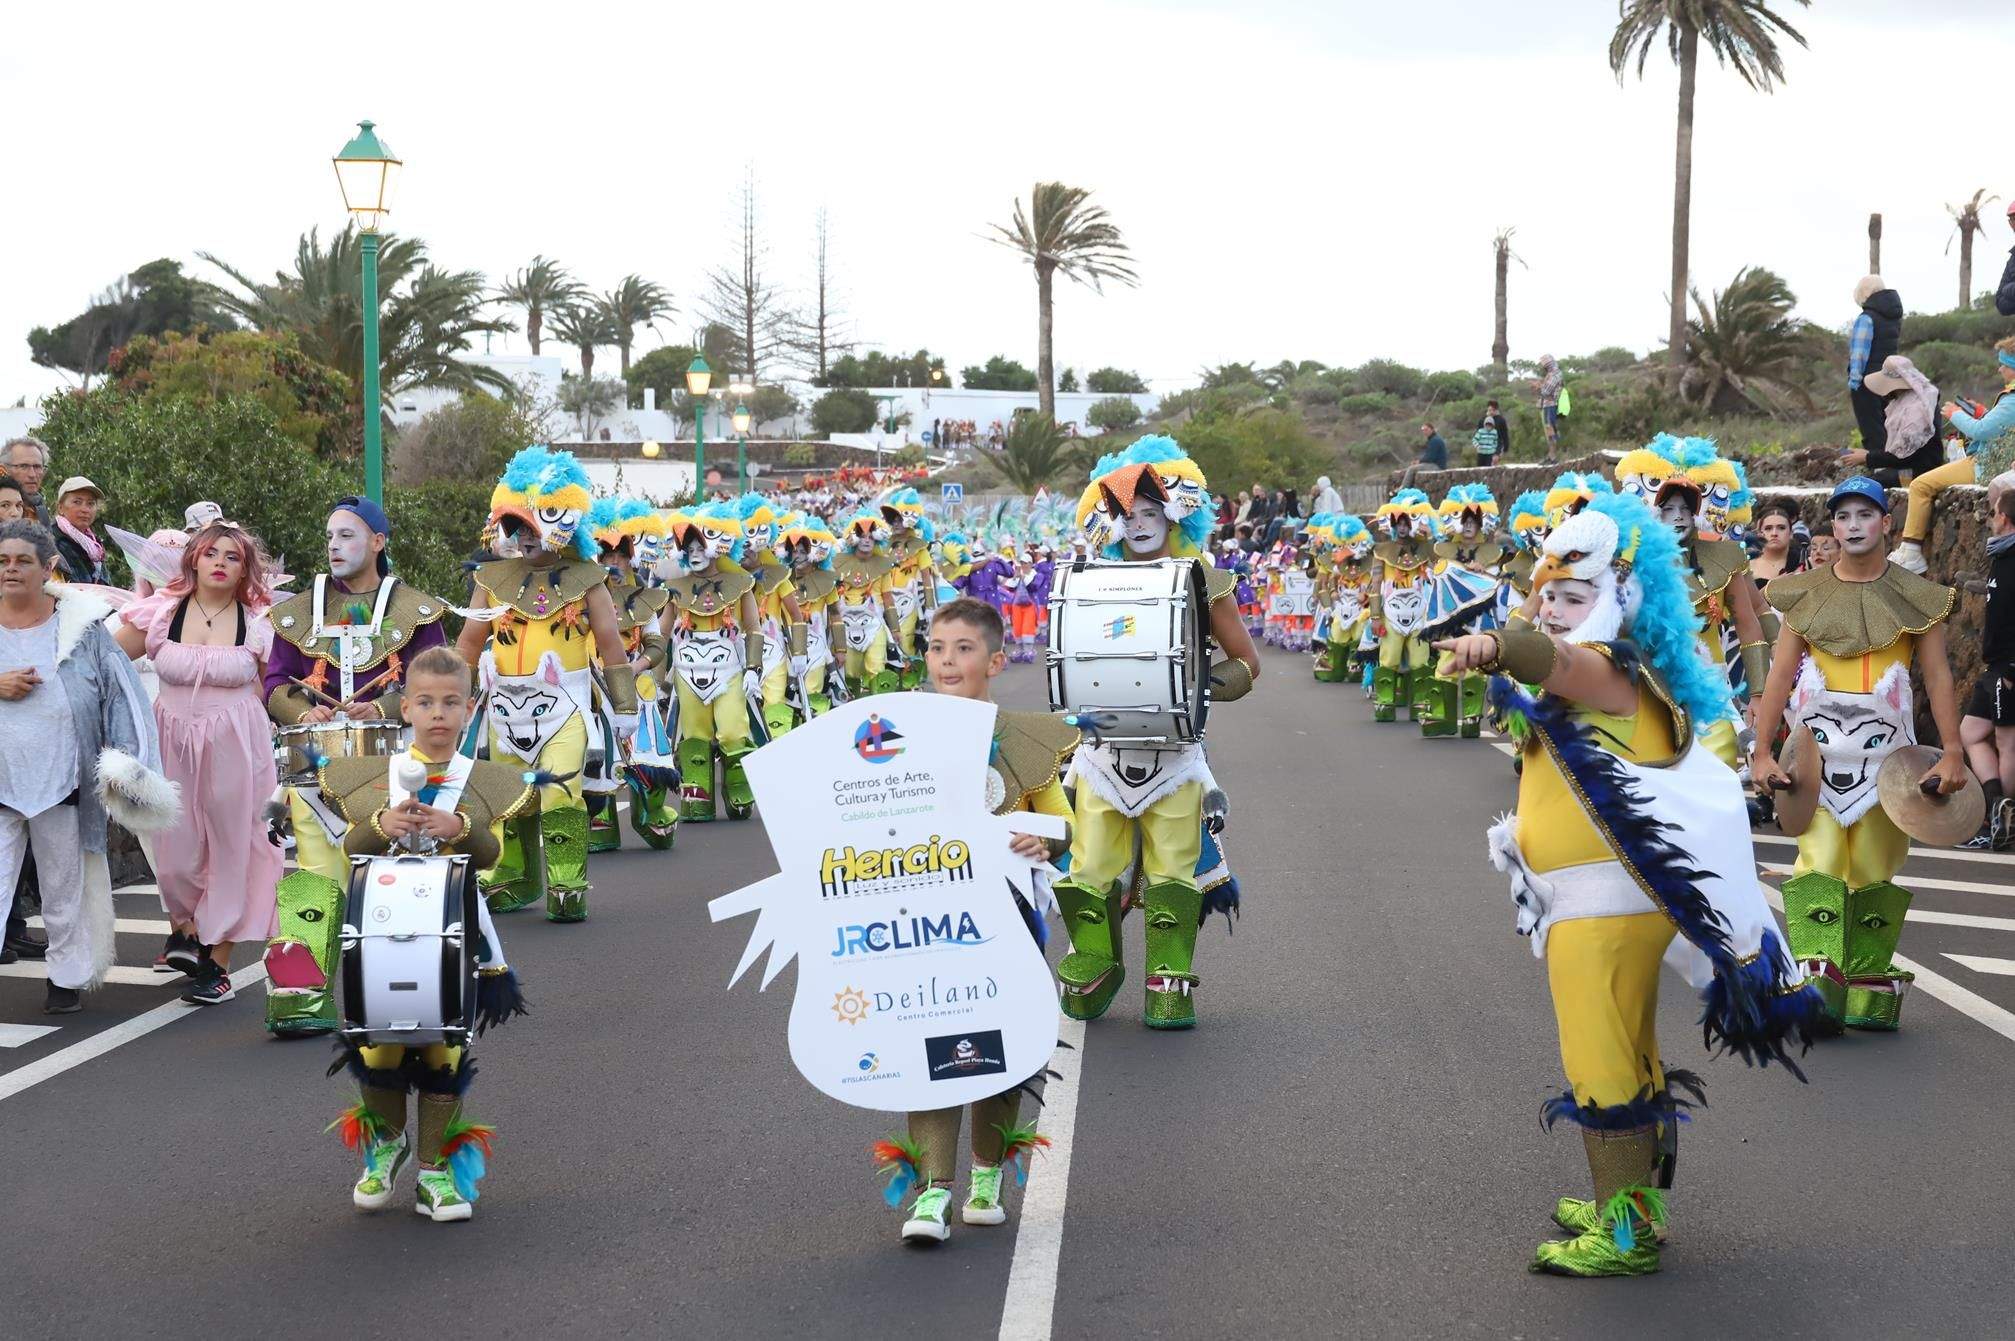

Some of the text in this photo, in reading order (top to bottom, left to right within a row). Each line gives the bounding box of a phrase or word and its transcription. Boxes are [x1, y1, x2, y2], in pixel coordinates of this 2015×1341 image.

[833, 772, 934, 792] Centros de Arte,
[835, 786, 936, 806] Cultura y Turismo
[841, 804, 936, 822] Cabildo de Lanzarote
[820, 834, 970, 885] Hercio
[831, 911, 982, 957] JRCLIMA
[873, 976, 998, 1012] Deiland
[896, 1006, 974, 1021] Centro Comercial
